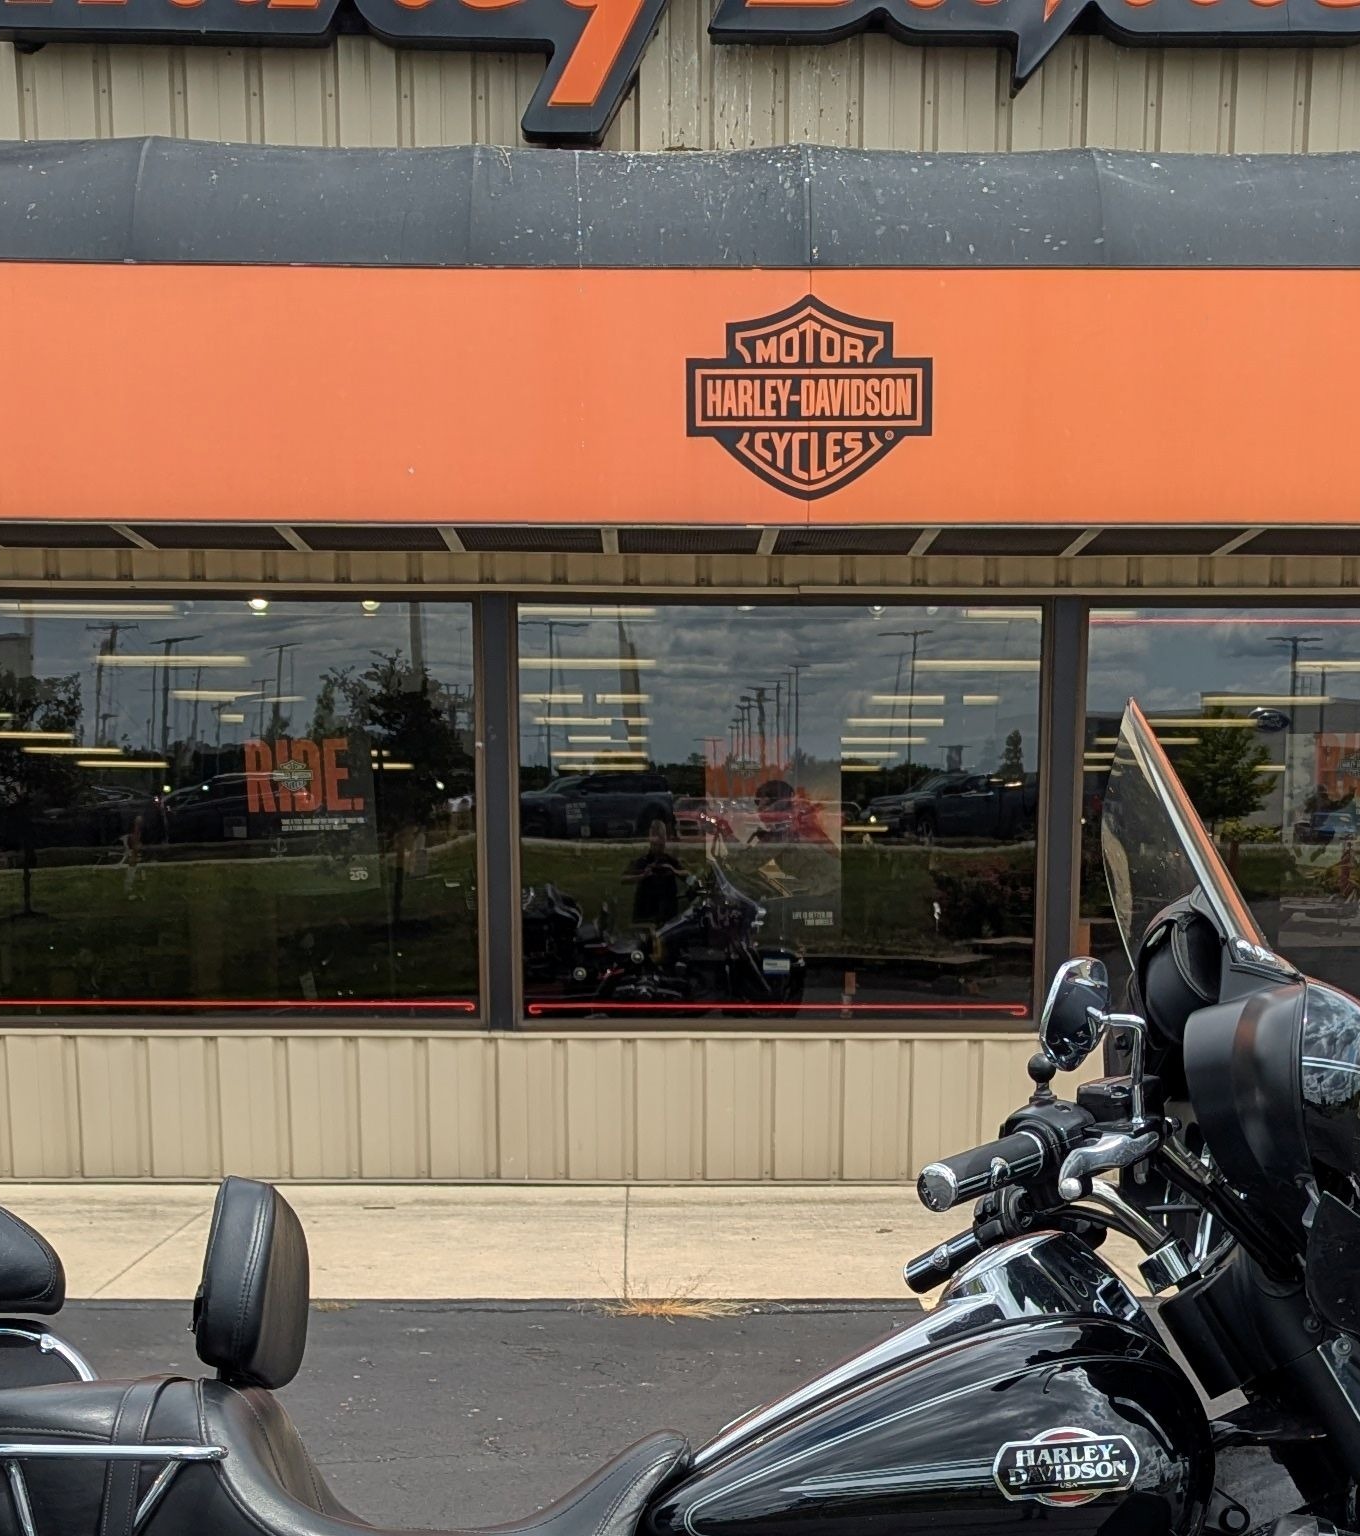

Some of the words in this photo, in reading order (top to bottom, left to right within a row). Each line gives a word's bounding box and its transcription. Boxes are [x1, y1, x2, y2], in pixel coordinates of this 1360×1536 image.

[755, 319, 864, 364] MOTOR
[706, 377, 913, 417] HARLEY-DAVIDSON
[754, 431, 863, 481] CYCLES
[243, 738, 365, 813] RIDE.
[1008, 1459, 1129, 1486] DAVIDSON
[1015, 1443, 1121, 1468] HARLEY-
